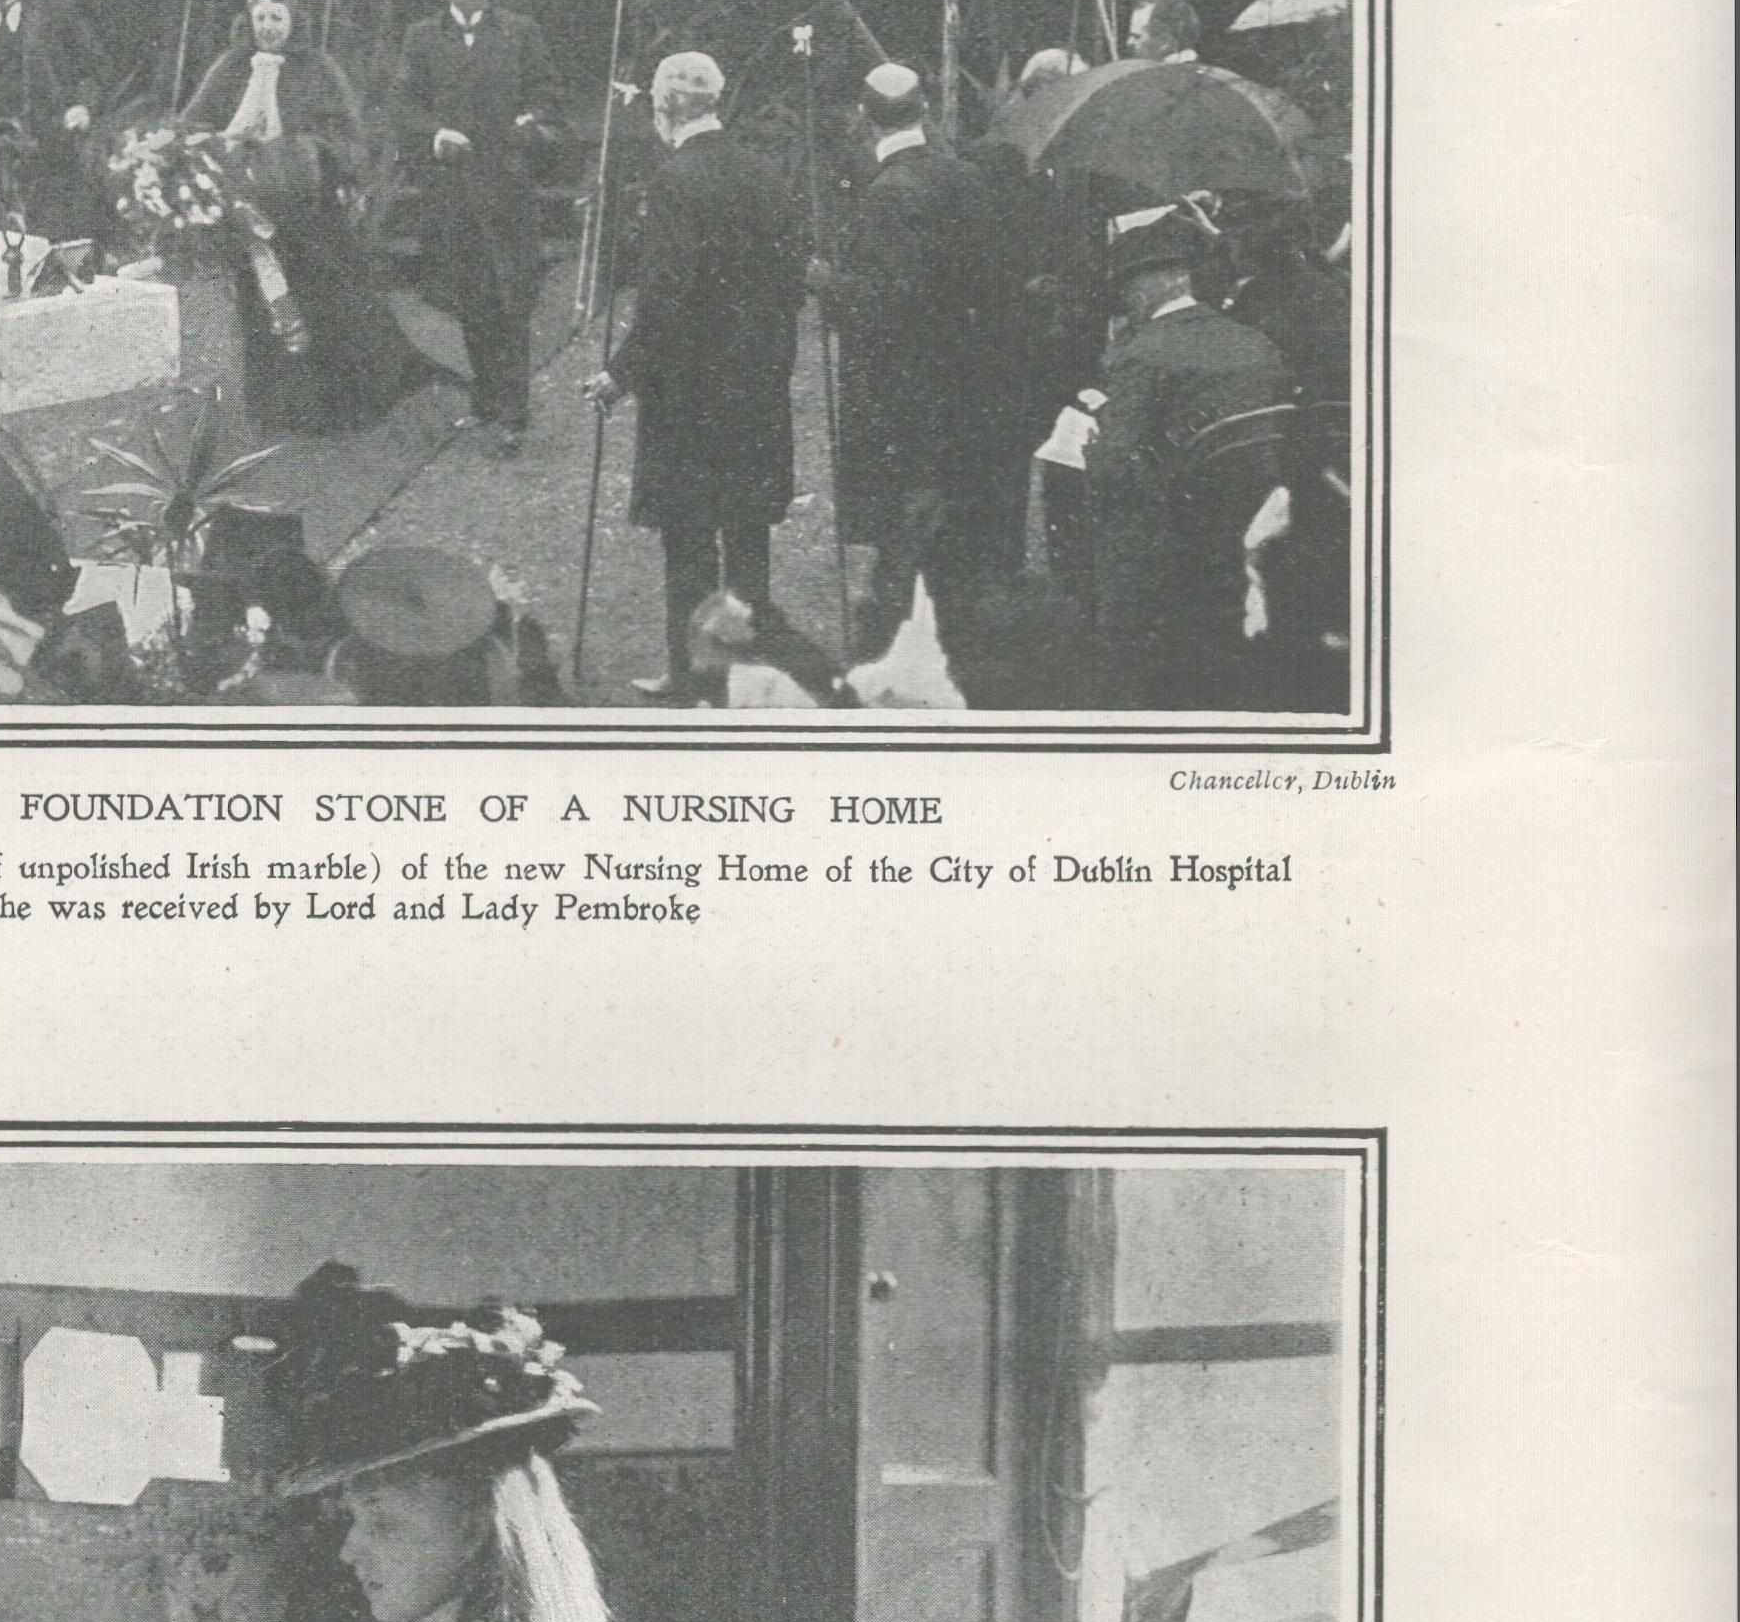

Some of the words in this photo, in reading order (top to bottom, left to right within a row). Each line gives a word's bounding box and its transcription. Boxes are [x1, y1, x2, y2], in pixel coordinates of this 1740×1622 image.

[1312, 770, 1396, 791] Dublin
[20, 793, 283, 822] FOUNDATION
[315, 793, 447, 822] STONE
[479, 795, 528, 823] OF
[560, 794, 590, 821] A
[623, 794, 795, 823] NURSING
[830, 796, 942, 825] HOME
[18, 852, 171, 887] unpolished
[186, 852, 251, 880] Irish
[267, 852, 381, 884] marble)
[401, 852, 429, 881] of
[444, 852, 488, 881] the
[505, 863, 566, 881] new
[584, 853, 702, 888] Nursing
[718, 854, 808, 883] Home
[825, 855, 853, 883] of
[869, 855, 913, 884] the
[929, 855, 994, 889] City
[1009, 854, 1037, 883] of
[1053, 855, 1153, 883] Dublin
[1169, 854, 1292, 891] Hospital
[48, 901, 106, 921] was
[121, 892, 239, 921] received
[254, 891, 291, 927] by
[306, 892, 376, 921] Lord
[393, 893, 445, 921] and
[461, 893, 539, 927] Lady
[555, 893, 700, 921] Pembroke
